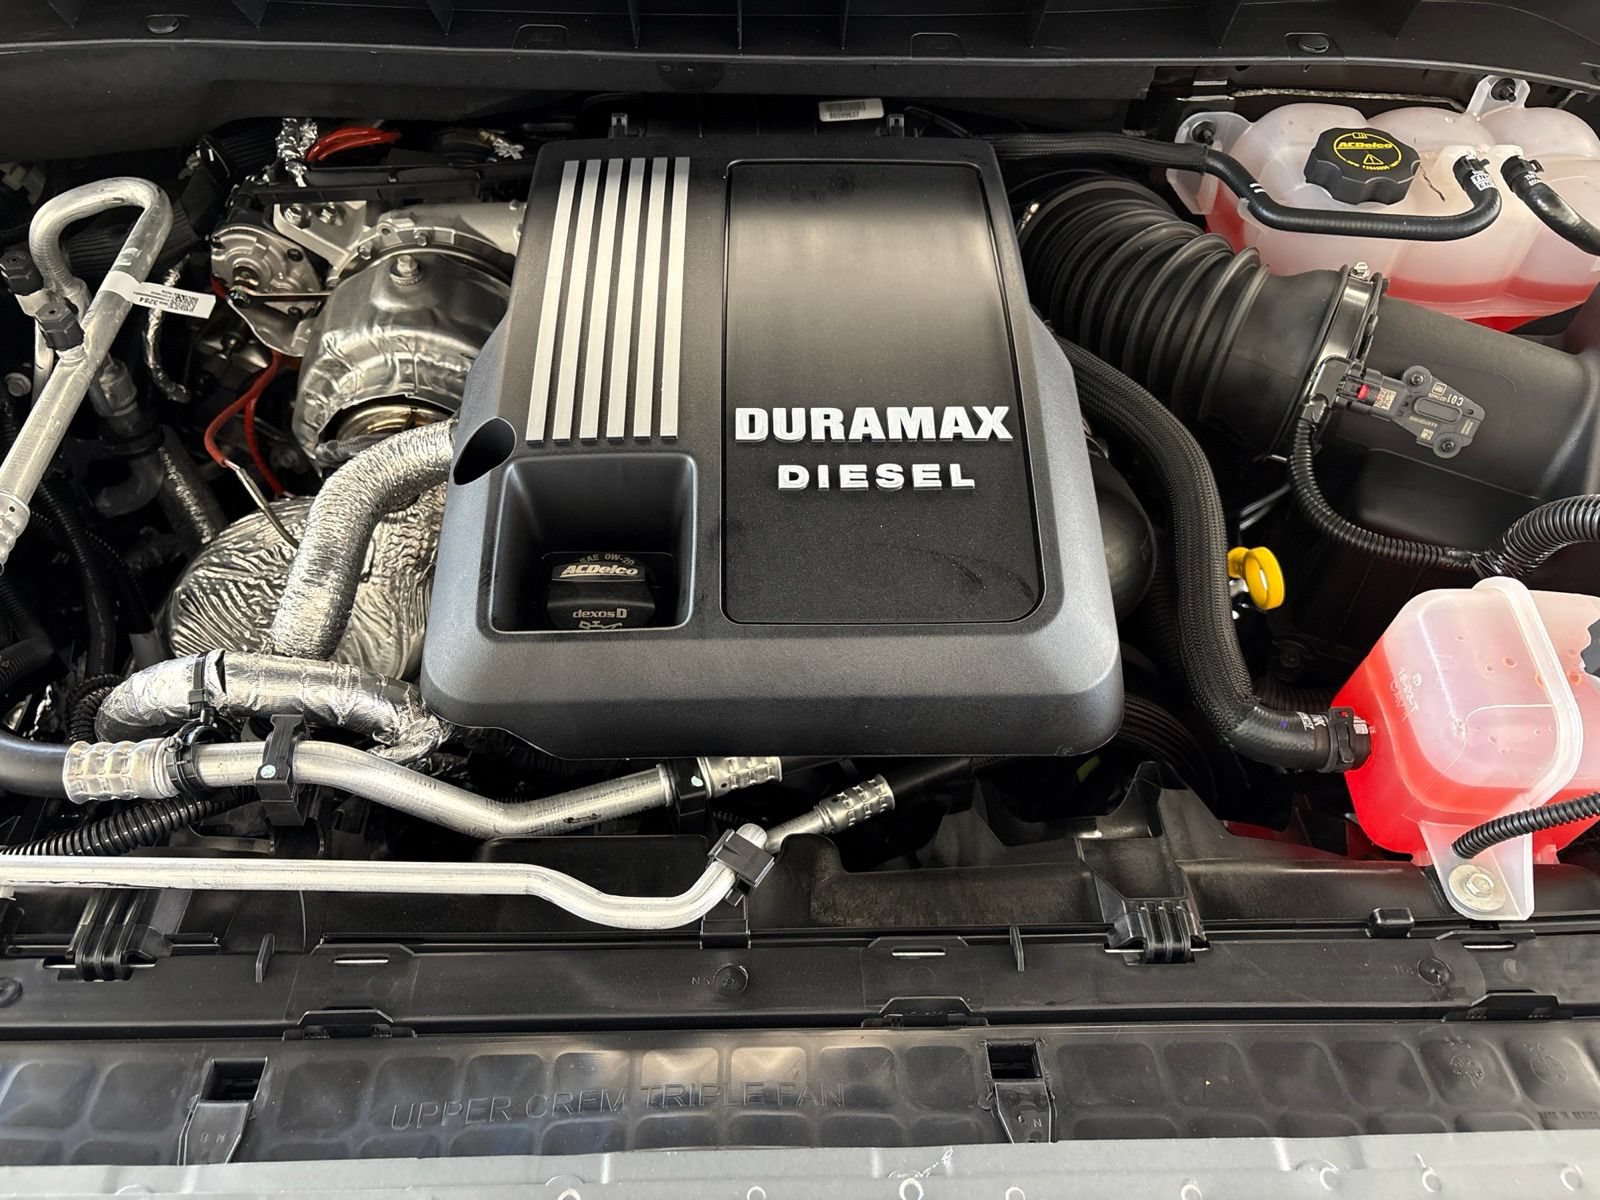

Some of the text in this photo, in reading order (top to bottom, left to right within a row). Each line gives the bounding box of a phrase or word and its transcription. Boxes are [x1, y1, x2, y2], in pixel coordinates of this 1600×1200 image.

[1337, 141, 1394, 150] ACDelco
[735, 406, 1014, 442] DURAMAX
[778, 463, 976, 491] DIESEL
[560, 564, 639, 577] ACDelco
[572, 608, 628, 619] dexosD
[391, 1096, 513, 1131] UPPER
[640, 1082, 764, 1109] TRIPLE
[776, 1081, 846, 1108] FAN
